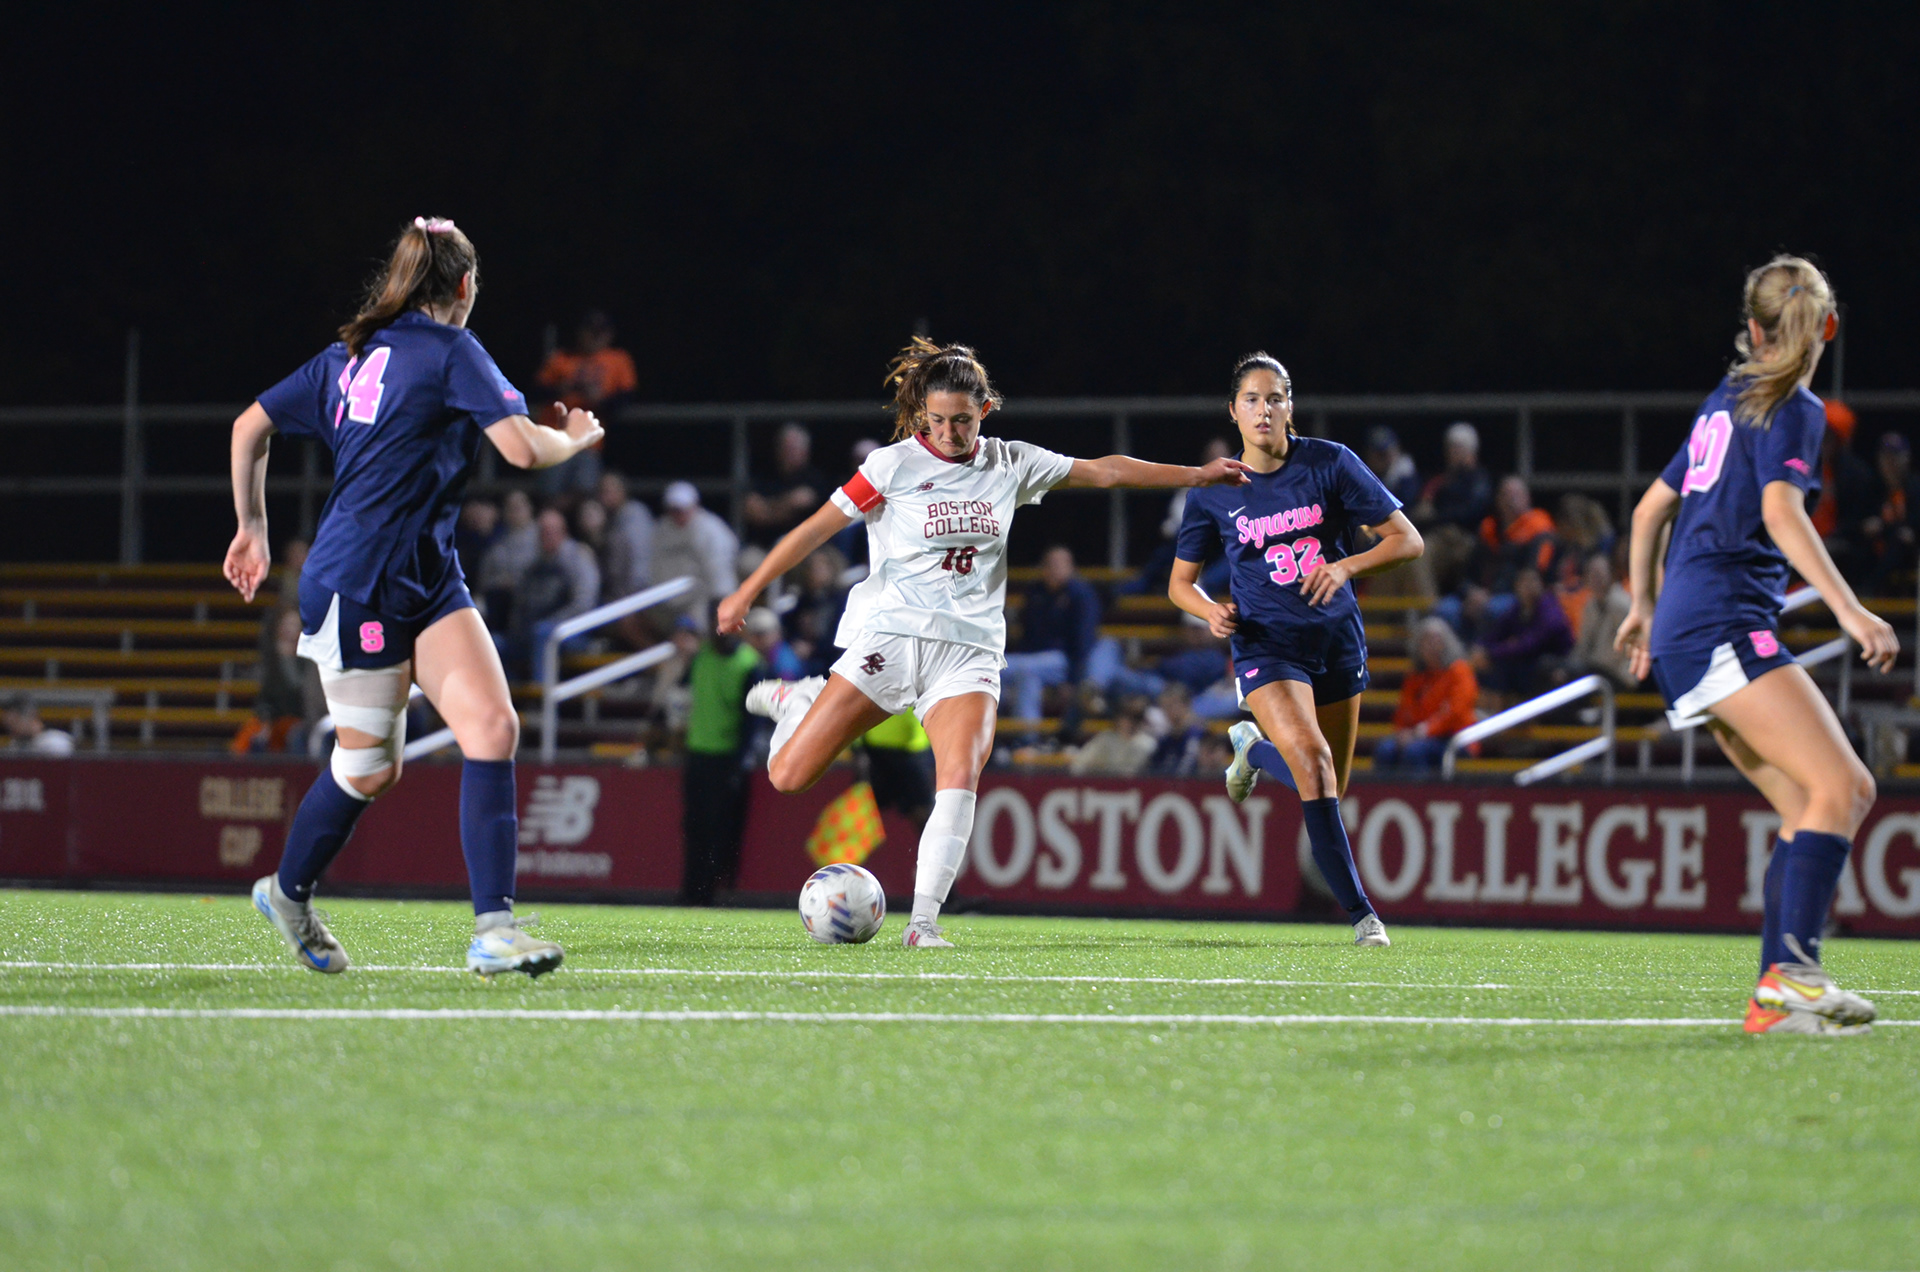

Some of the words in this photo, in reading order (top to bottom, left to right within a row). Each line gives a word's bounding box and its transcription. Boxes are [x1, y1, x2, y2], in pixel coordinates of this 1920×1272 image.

[923, 517, 1000, 539] COLLEGE
[927, 500, 993, 519] BOSTON
[1236, 503, 1324, 549] Syracuse
[1264, 536, 1326, 586] 32
[359, 620, 386, 653] S
[957, 786, 1273, 897] OSTON
